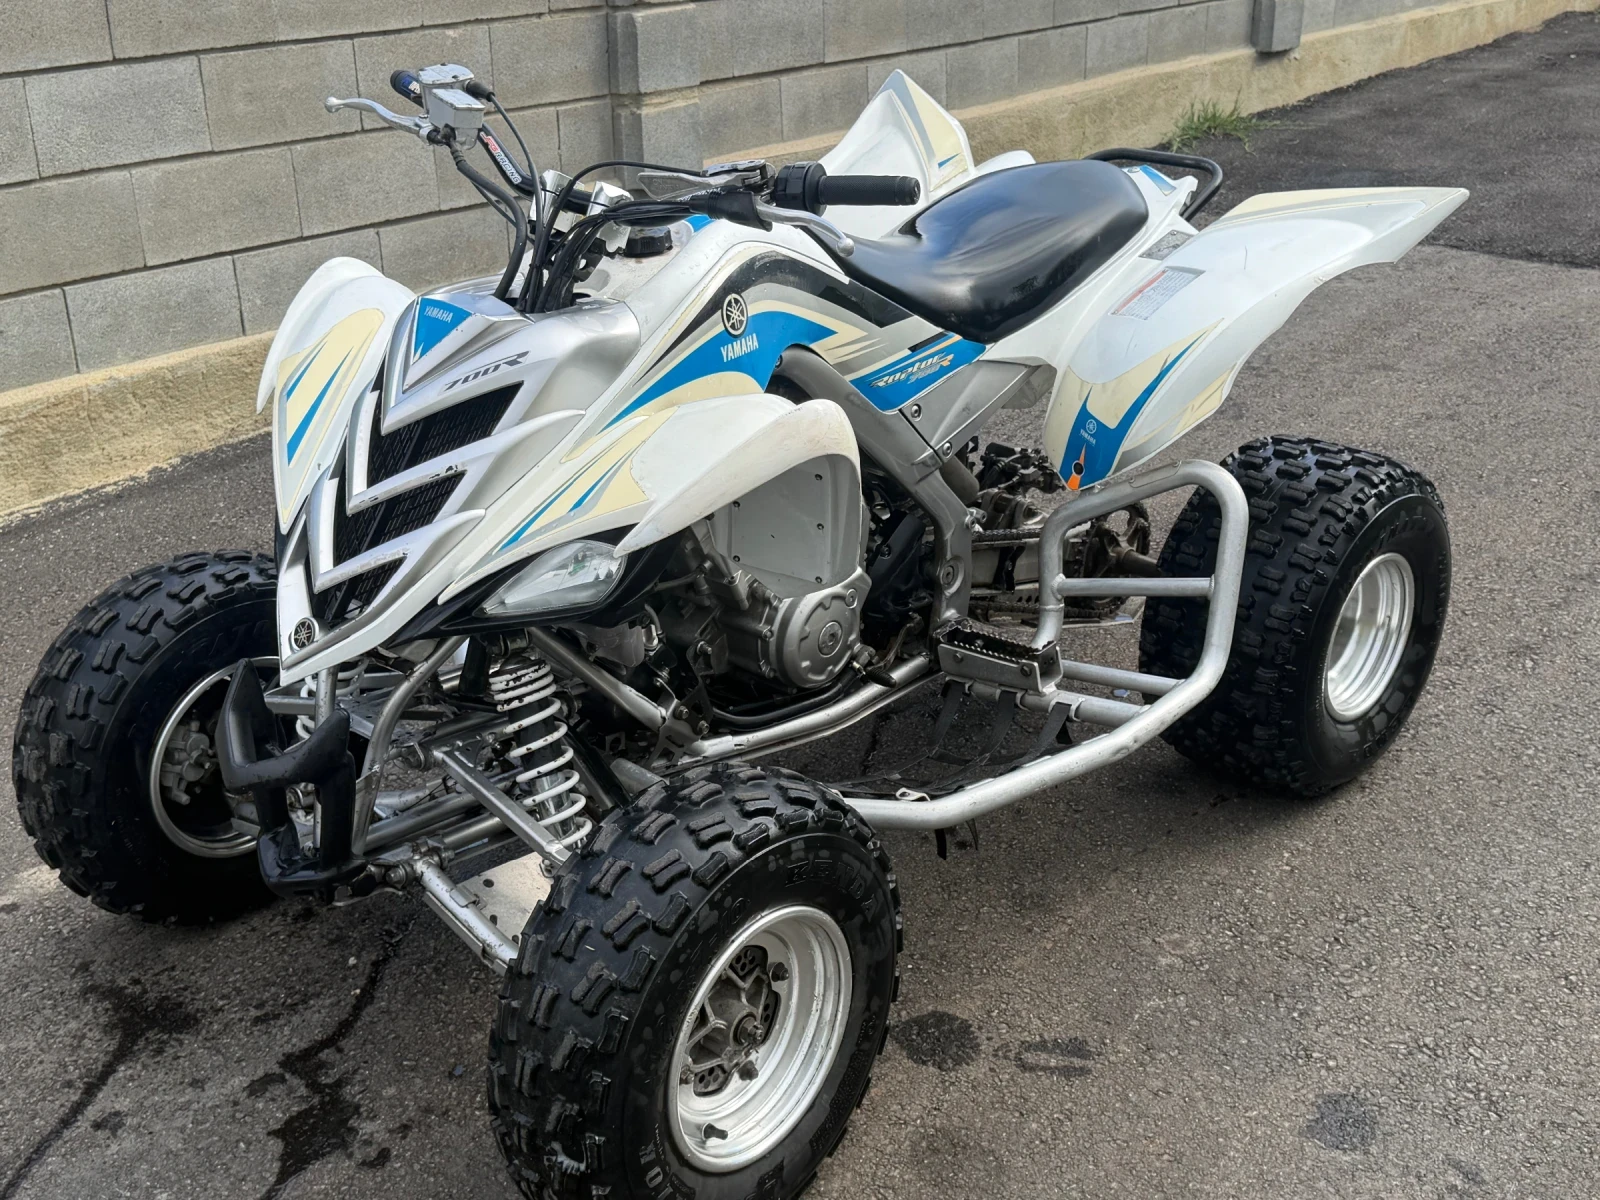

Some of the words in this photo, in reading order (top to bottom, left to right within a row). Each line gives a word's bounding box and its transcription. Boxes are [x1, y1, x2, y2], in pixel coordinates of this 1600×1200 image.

[495, 151, 521, 184] RACING
[424, 305, 454, 324] YAMAHA
[720, 332, 759, 363] YAMAHA
[444, 350, 531, 392] 700R
